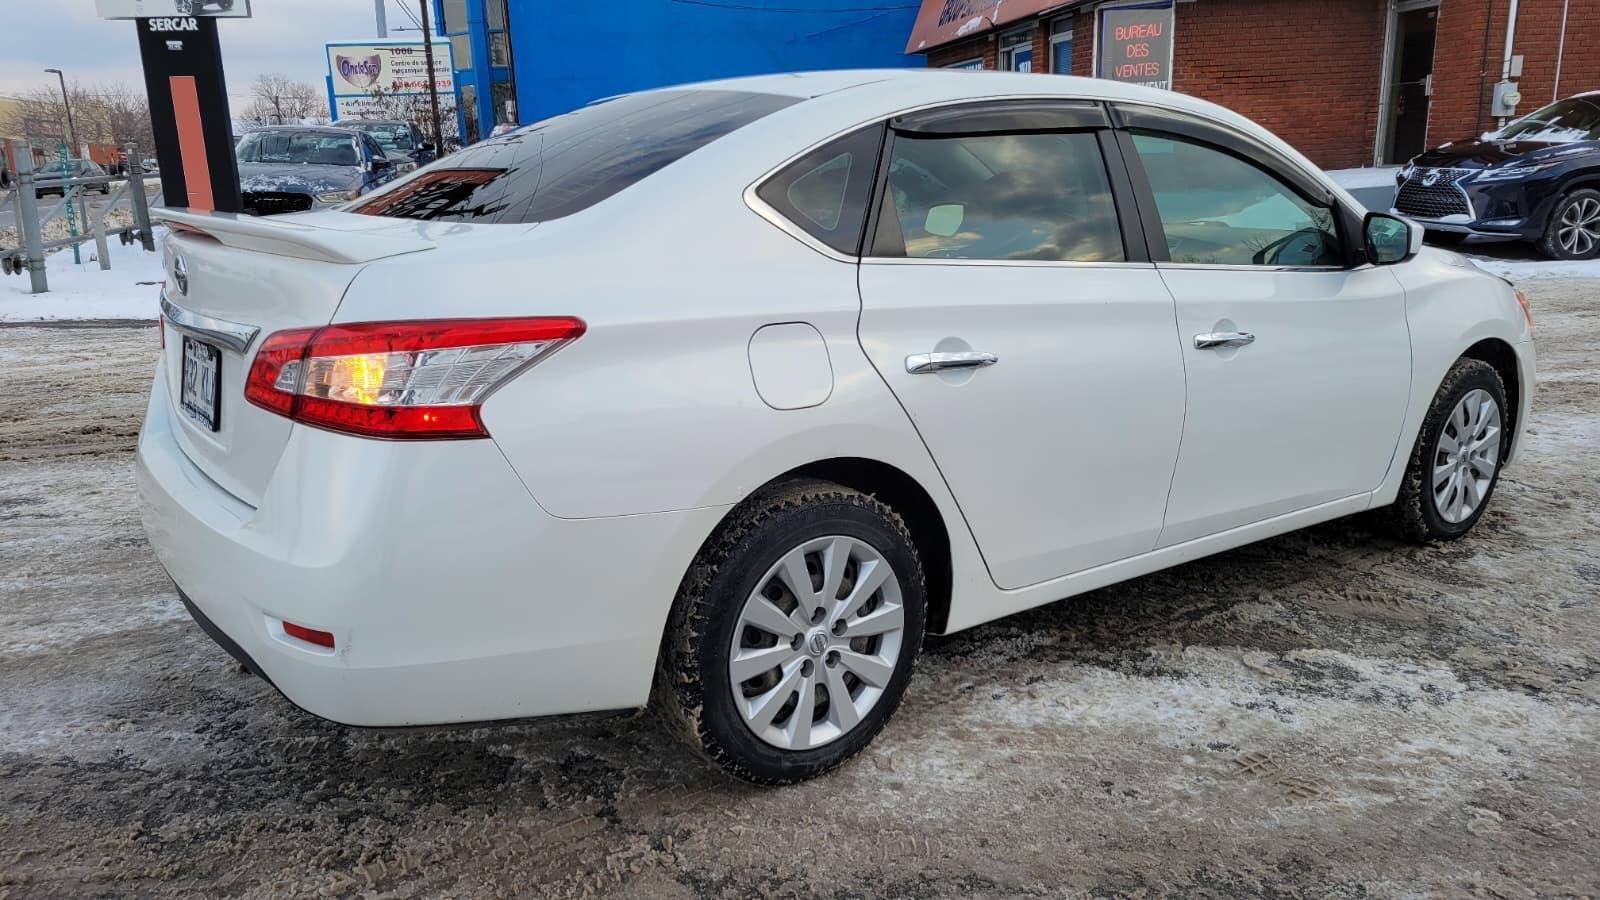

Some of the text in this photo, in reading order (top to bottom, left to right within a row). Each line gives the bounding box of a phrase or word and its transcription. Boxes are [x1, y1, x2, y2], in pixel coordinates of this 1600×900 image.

[148, 18, 199, 31] SERCAR
[1115, 22, 1163, 41] BUREAU
[1126, 42, 1150, 58] DES
[1115, 62, 1160, 78] VENTES
